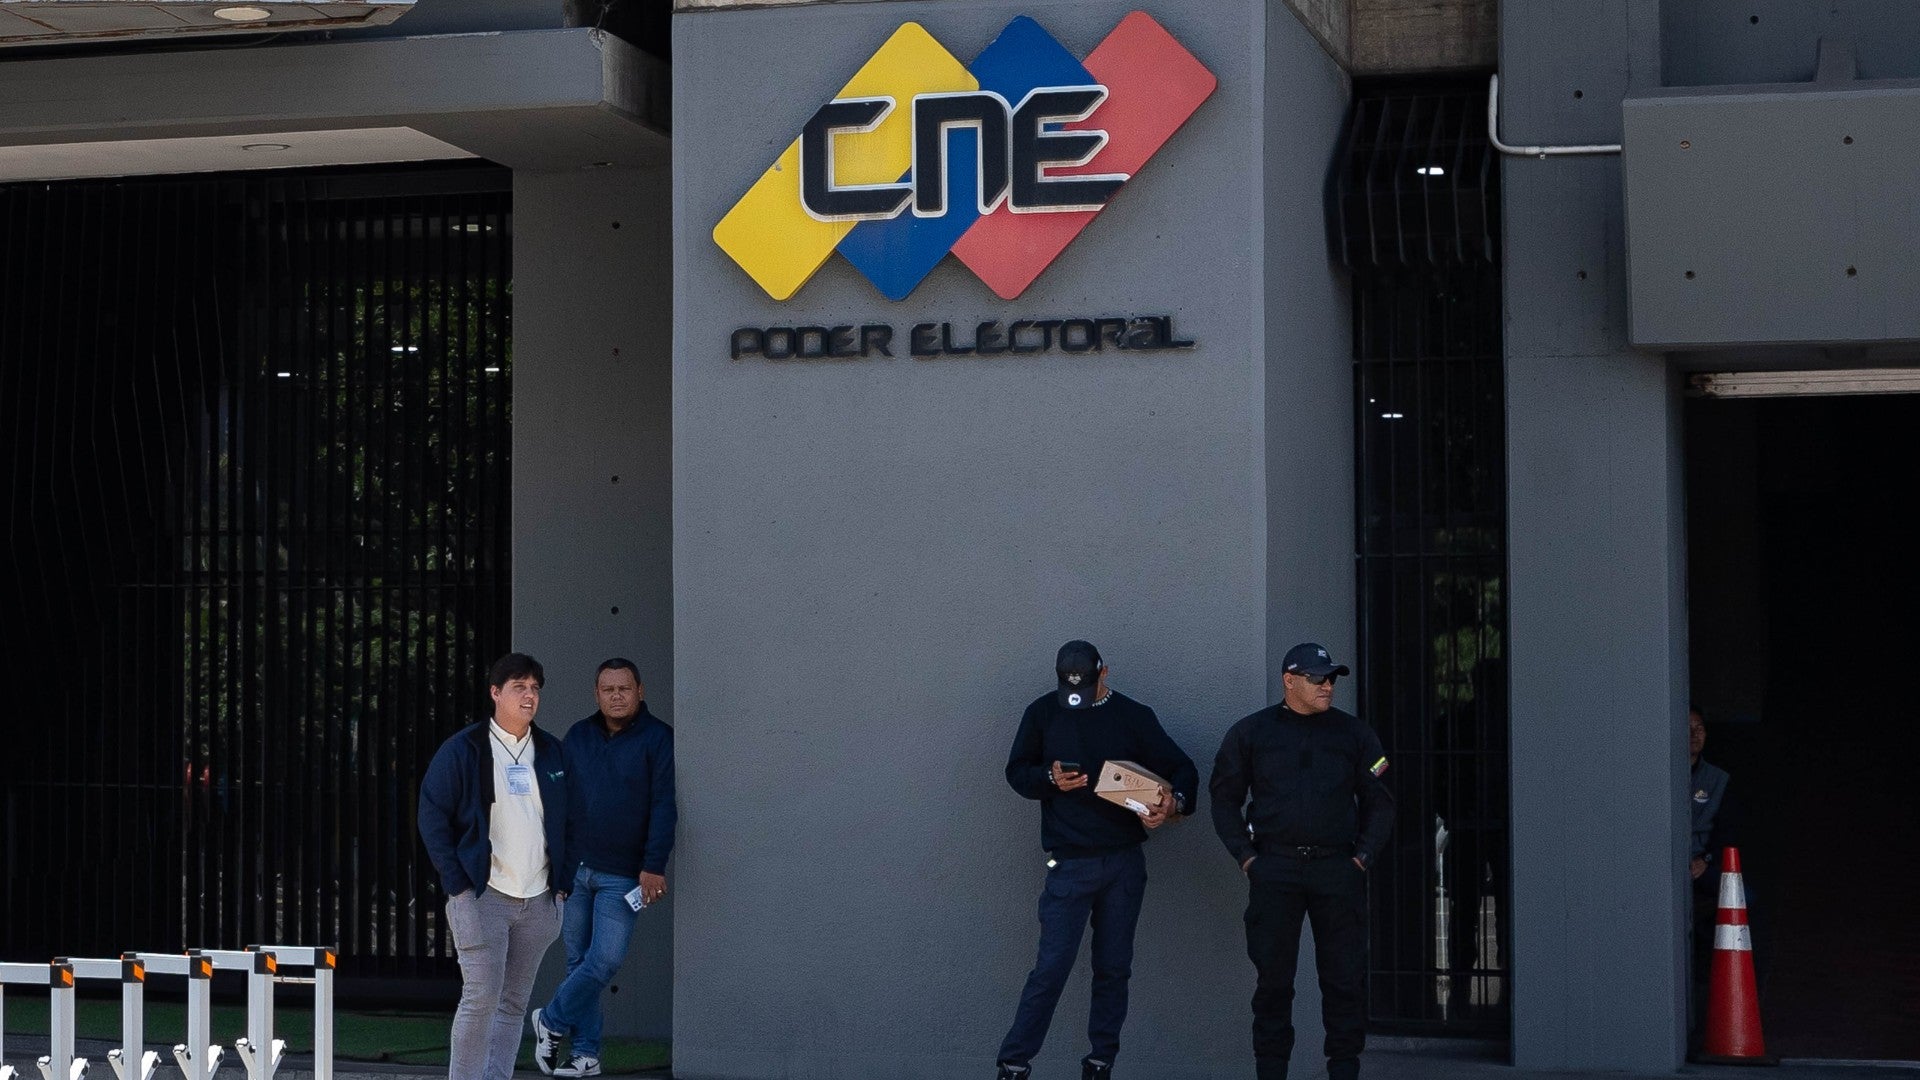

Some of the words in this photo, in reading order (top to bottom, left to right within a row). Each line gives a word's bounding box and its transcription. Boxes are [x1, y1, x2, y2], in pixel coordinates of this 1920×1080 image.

[800, 85, 1130, 222] CNE
[731, 323, 894, 360] PODER
[911, 316, 1195, 356] ELECTORAL
